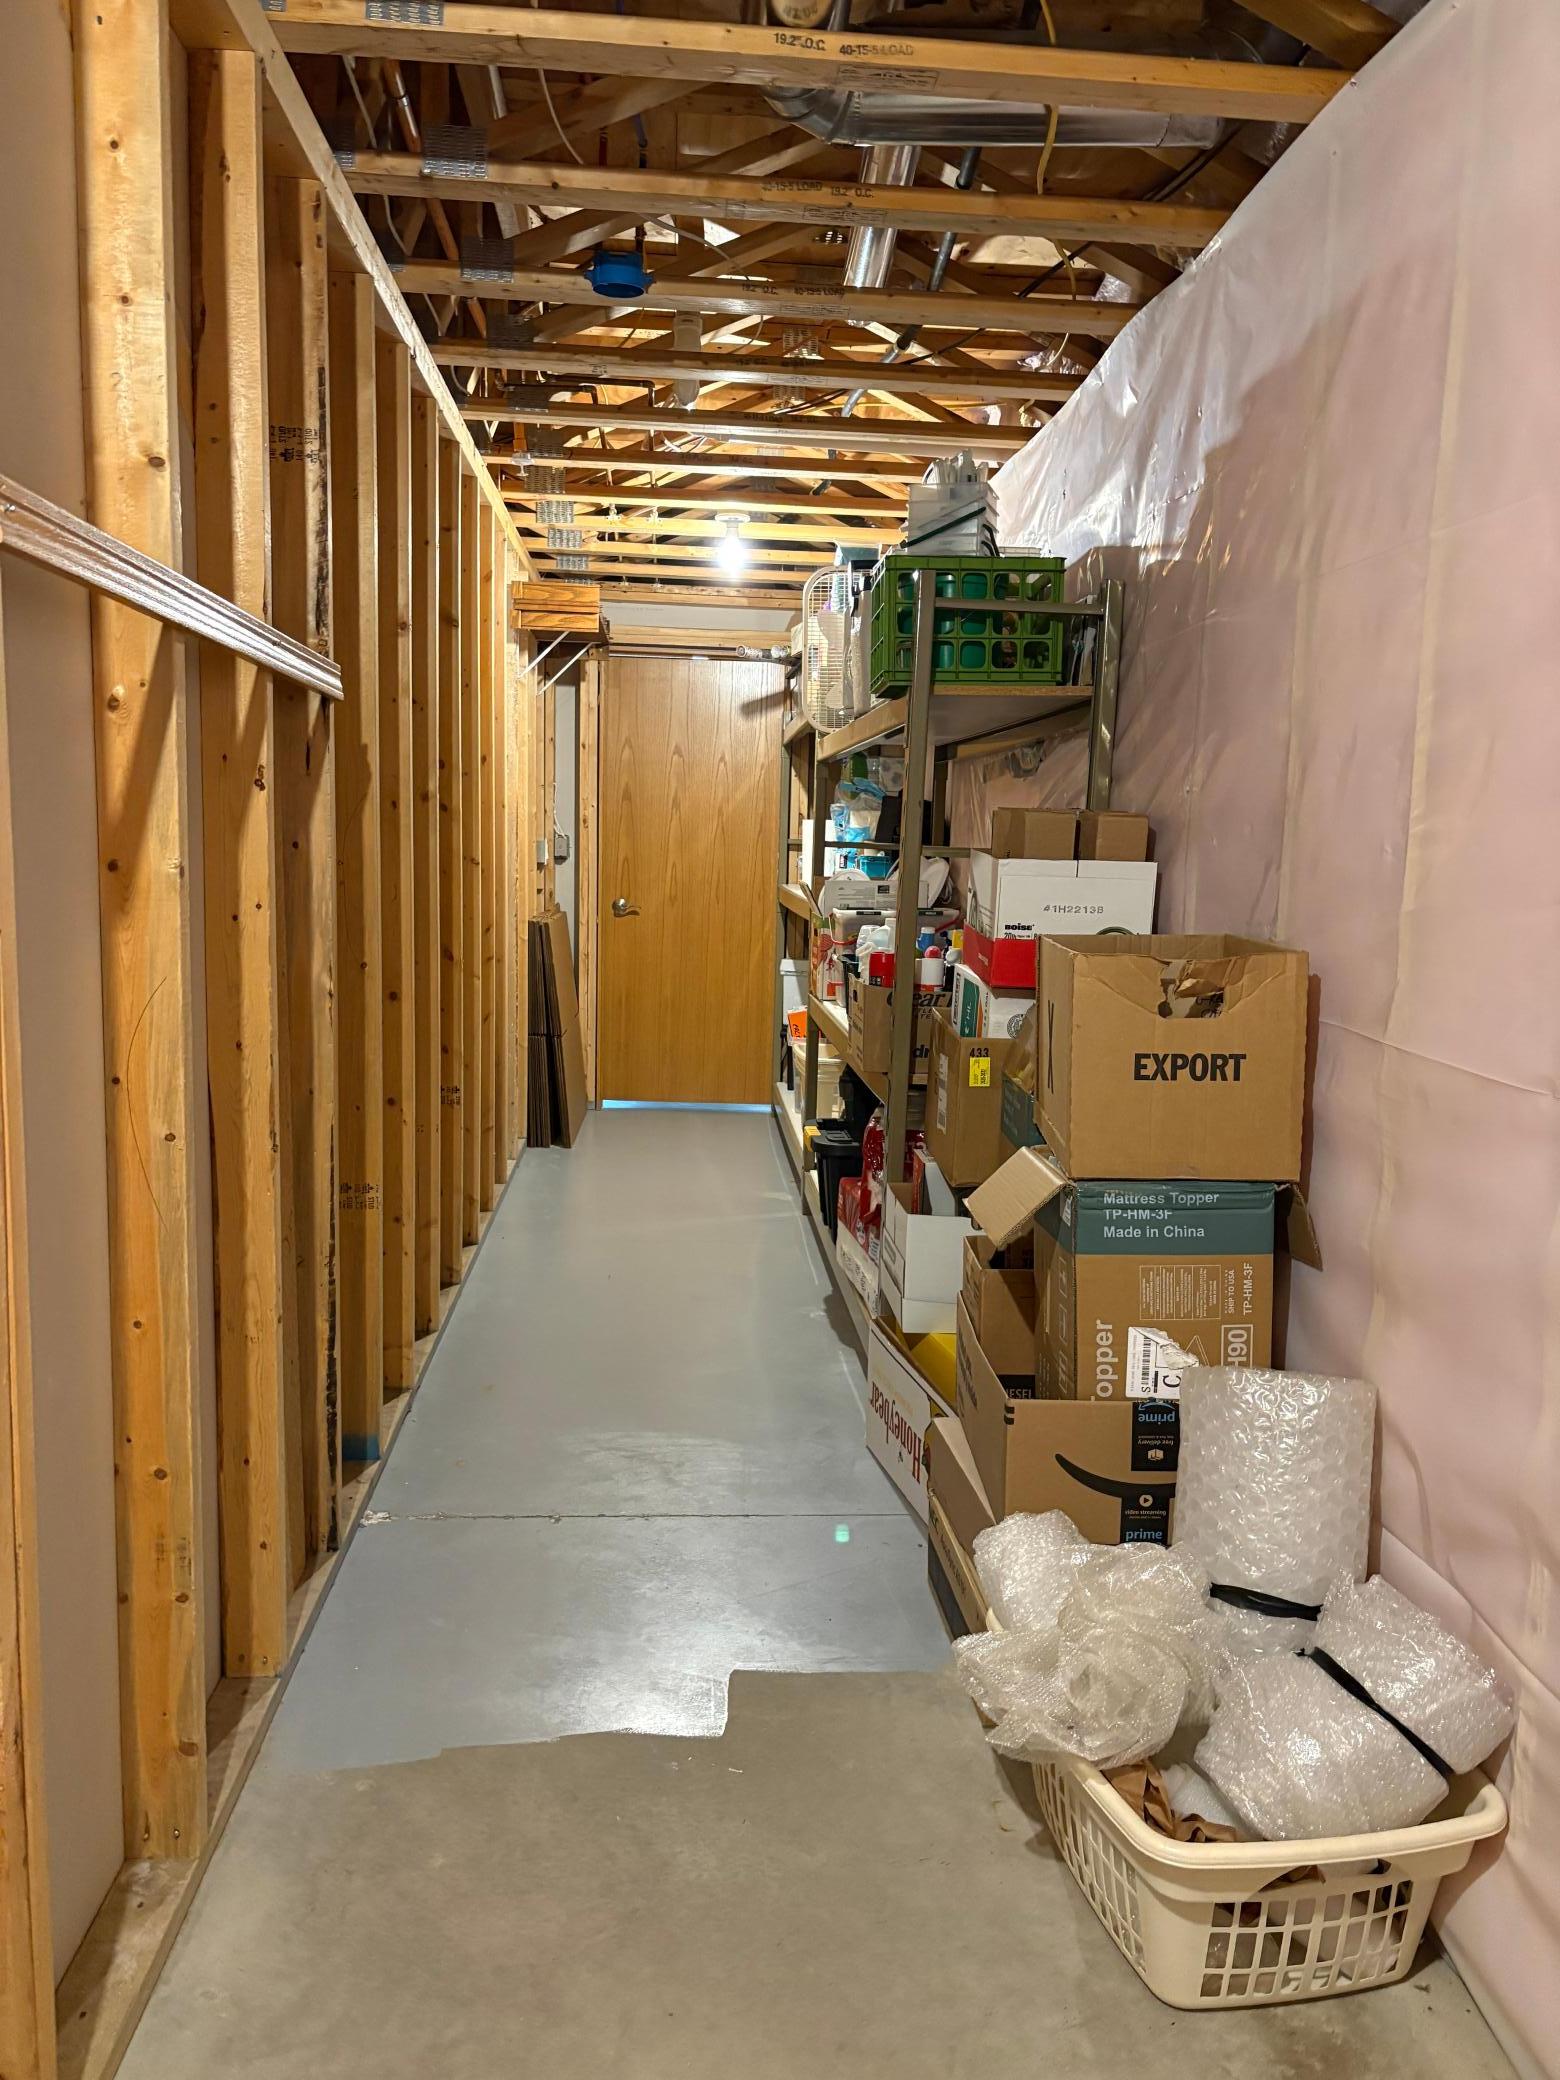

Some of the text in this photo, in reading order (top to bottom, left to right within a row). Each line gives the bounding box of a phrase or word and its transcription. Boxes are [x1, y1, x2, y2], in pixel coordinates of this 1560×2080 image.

[1134, 1053, 1247, 1082] EXPORT
[1103, 1192, 1220, 1207] Mattress Topper
[1104, 1208, 1174, 1221] TP-HM-3F
[1103, 1225, 1205, 1238] Made in China
[1227, 1269, 1236, 1314] SHIP TO USA
[1243, 1262, 1253, 1316] TP-HM-3F
[1090, 1319, 1119, 1402] opper
[1138, 1412, 1176, 1425] prime
[869, 1381, 922, 1485] Honeybear
[1140, 1508, 1167, 1517] streaming
[1125, 1528, 1164, 1542] prime
